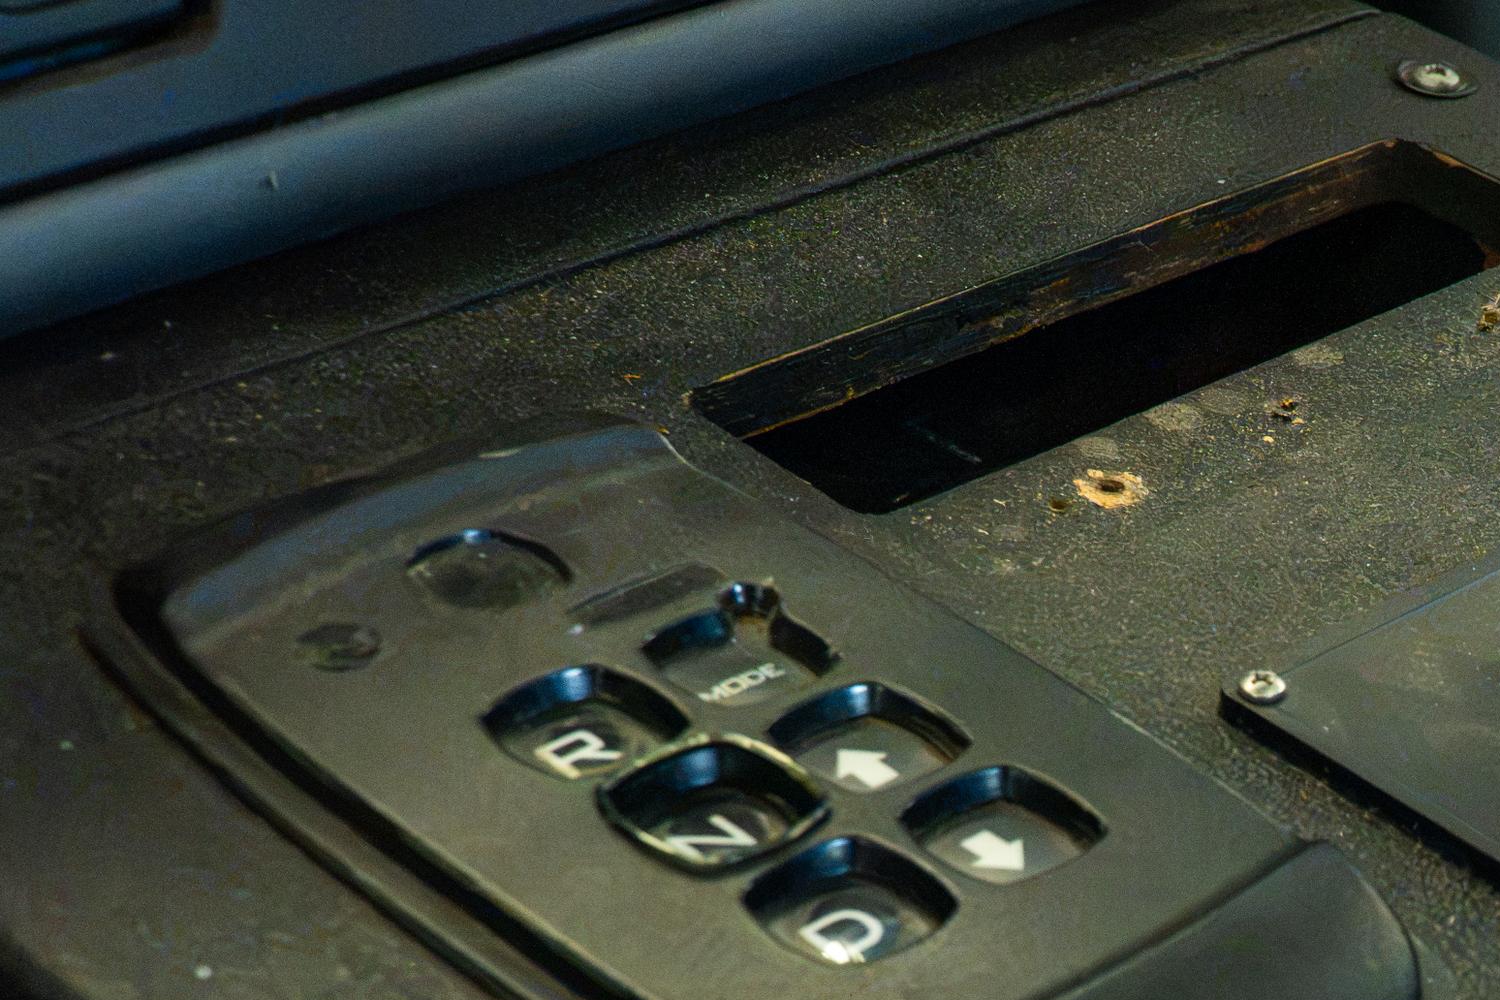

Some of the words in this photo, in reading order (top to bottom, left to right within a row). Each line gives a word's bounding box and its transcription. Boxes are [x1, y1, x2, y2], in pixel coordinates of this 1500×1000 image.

[698, 663, 786, 702] MODE
[534, 729, 624, 780] R
[664, 814, 758, 865] N
